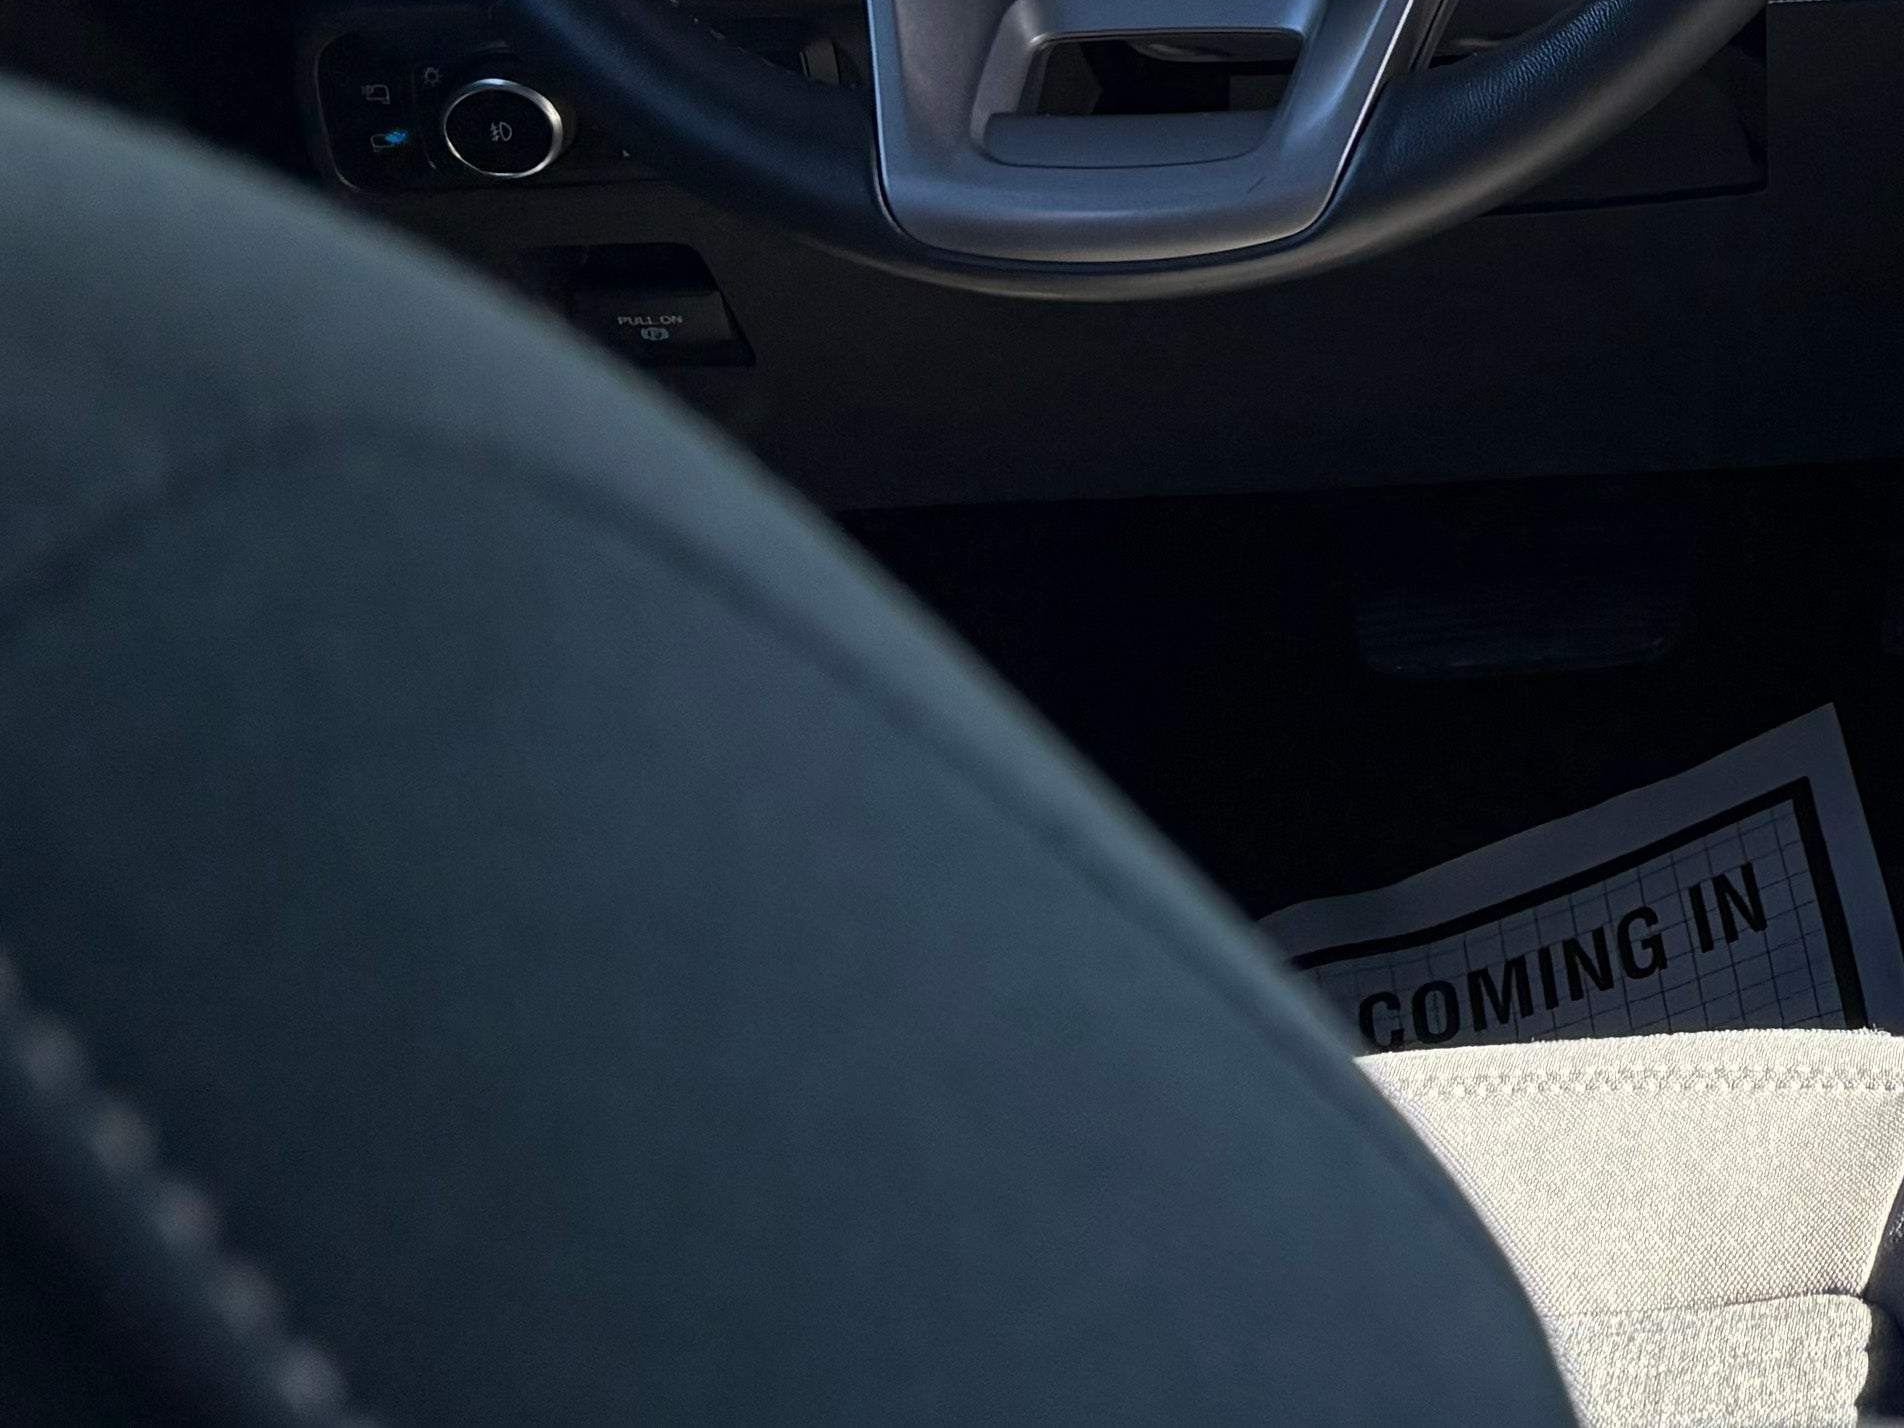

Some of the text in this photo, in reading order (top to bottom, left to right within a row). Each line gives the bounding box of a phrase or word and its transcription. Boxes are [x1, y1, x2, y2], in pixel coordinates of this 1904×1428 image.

[617, 314, 682, 326] PULL ON
[1358, 861, 1767, 1050] COMING IN
